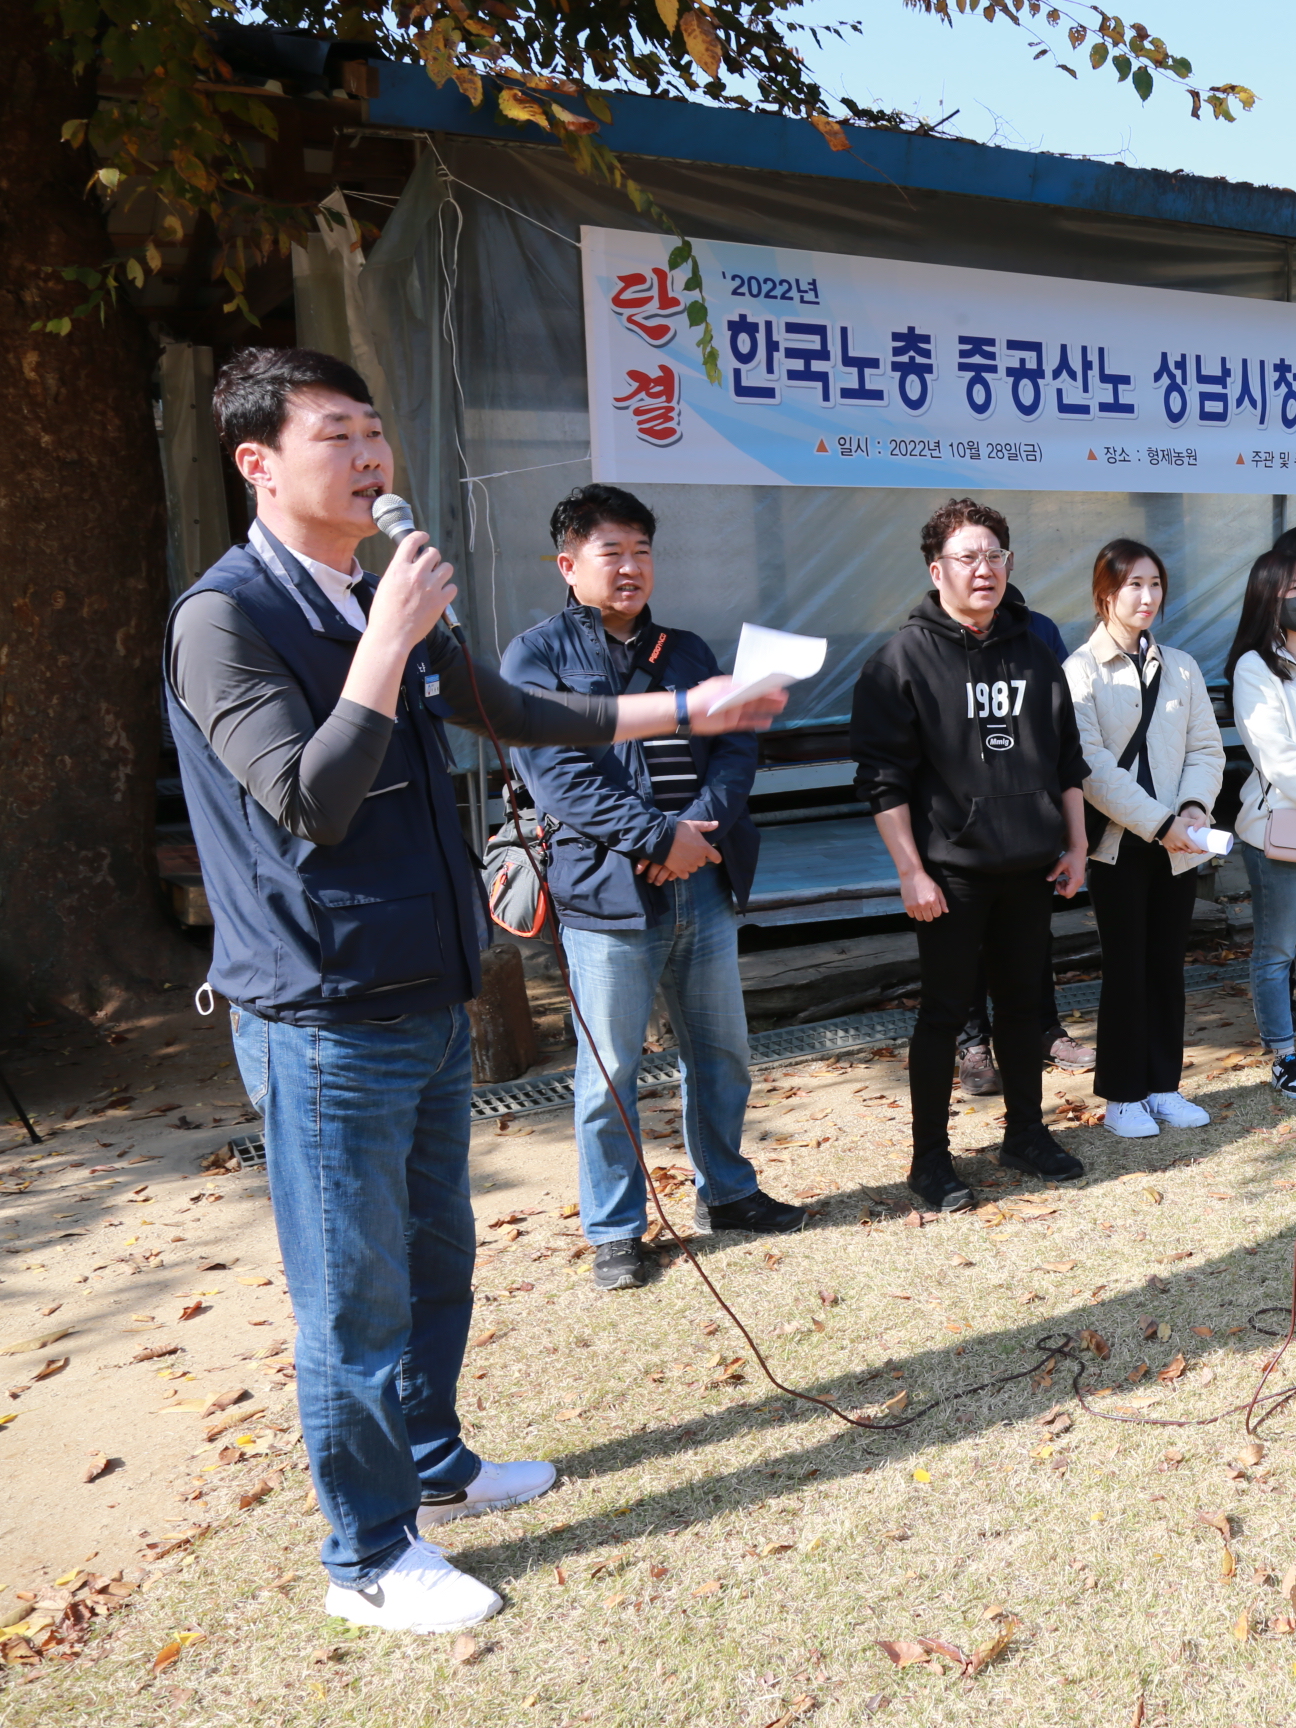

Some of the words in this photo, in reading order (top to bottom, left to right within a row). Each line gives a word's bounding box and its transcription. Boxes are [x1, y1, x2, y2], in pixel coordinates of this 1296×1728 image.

[721, 271, 820, 304] '2022년
[611, 266, 683, 441] 단결
[726, 313, 934, 411] 한국노총
[957, 334, 1136, 416] 중공산노
[837, 436, 870, 458] 일시
[889, 439, 942, 459] 2022년
[948, 440, 982, 461] 10월
[986, 442, 1043, 463] 28일(금)
[1103, 446, 1132, 465] 장소
[1146, 447, 1198, 467] 형제농원
[1251, 450, 1275, 469] 주관
[1279, 451, 1290, 469] 및
[965, 679, 1027, 719] 1987
[989, 738, 1010, 747] Mmlg
